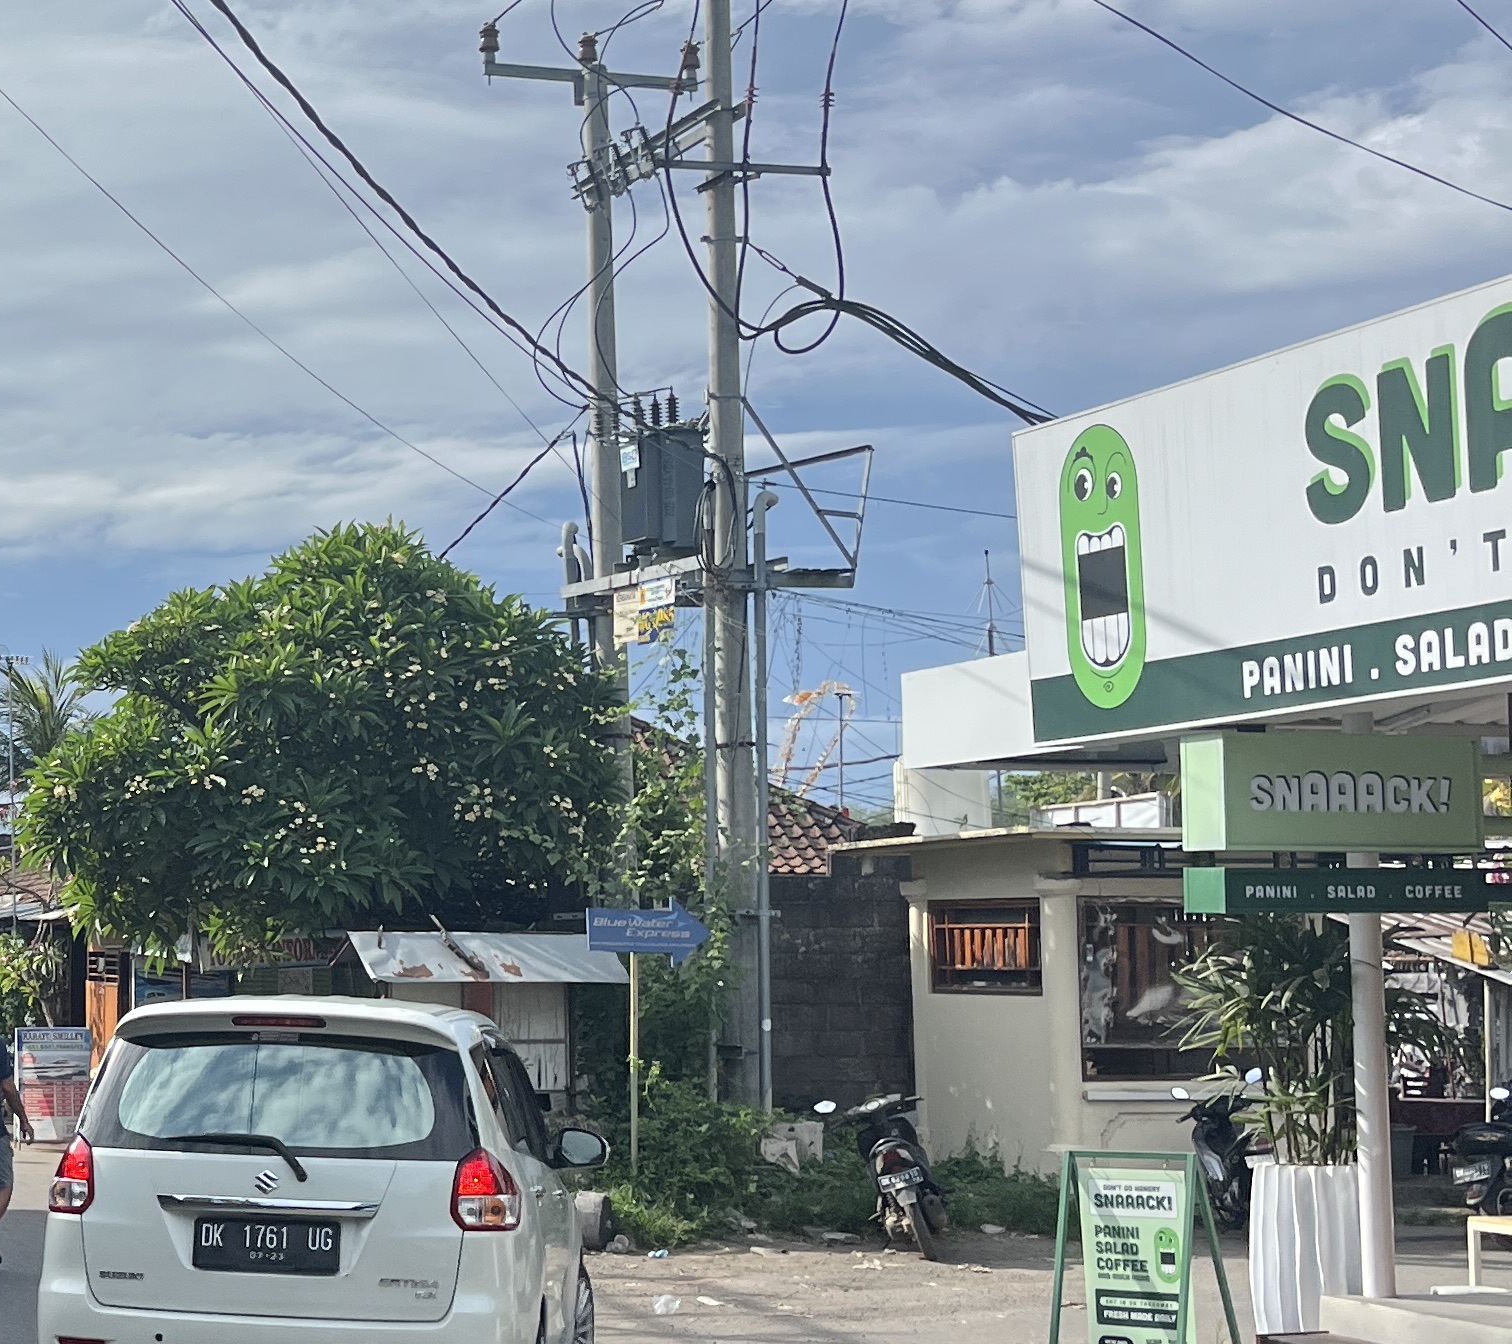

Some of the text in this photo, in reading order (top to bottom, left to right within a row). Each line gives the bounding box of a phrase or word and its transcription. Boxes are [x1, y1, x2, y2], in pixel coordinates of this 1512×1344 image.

[1317, 529, 1506, 604] DON'T
[1242, 644, 1353, 699] PANINI
[1250, 770, 1452, 814] SNAAACK!
[1245, 885, 1463, 899] PANINI SALAD COFFEE
[626, 927, 691, 939] Express
[1093, 1193, 1173, 1212] SNAAACK!
[201, 1223, 334, 1251] DK 1761 UG
[1094, 1225, 1140, 1240] PANINI
[1096, 1241, 1140, 1256] SALAD
[1097, 1257, 1149, 1273] COFFEE
